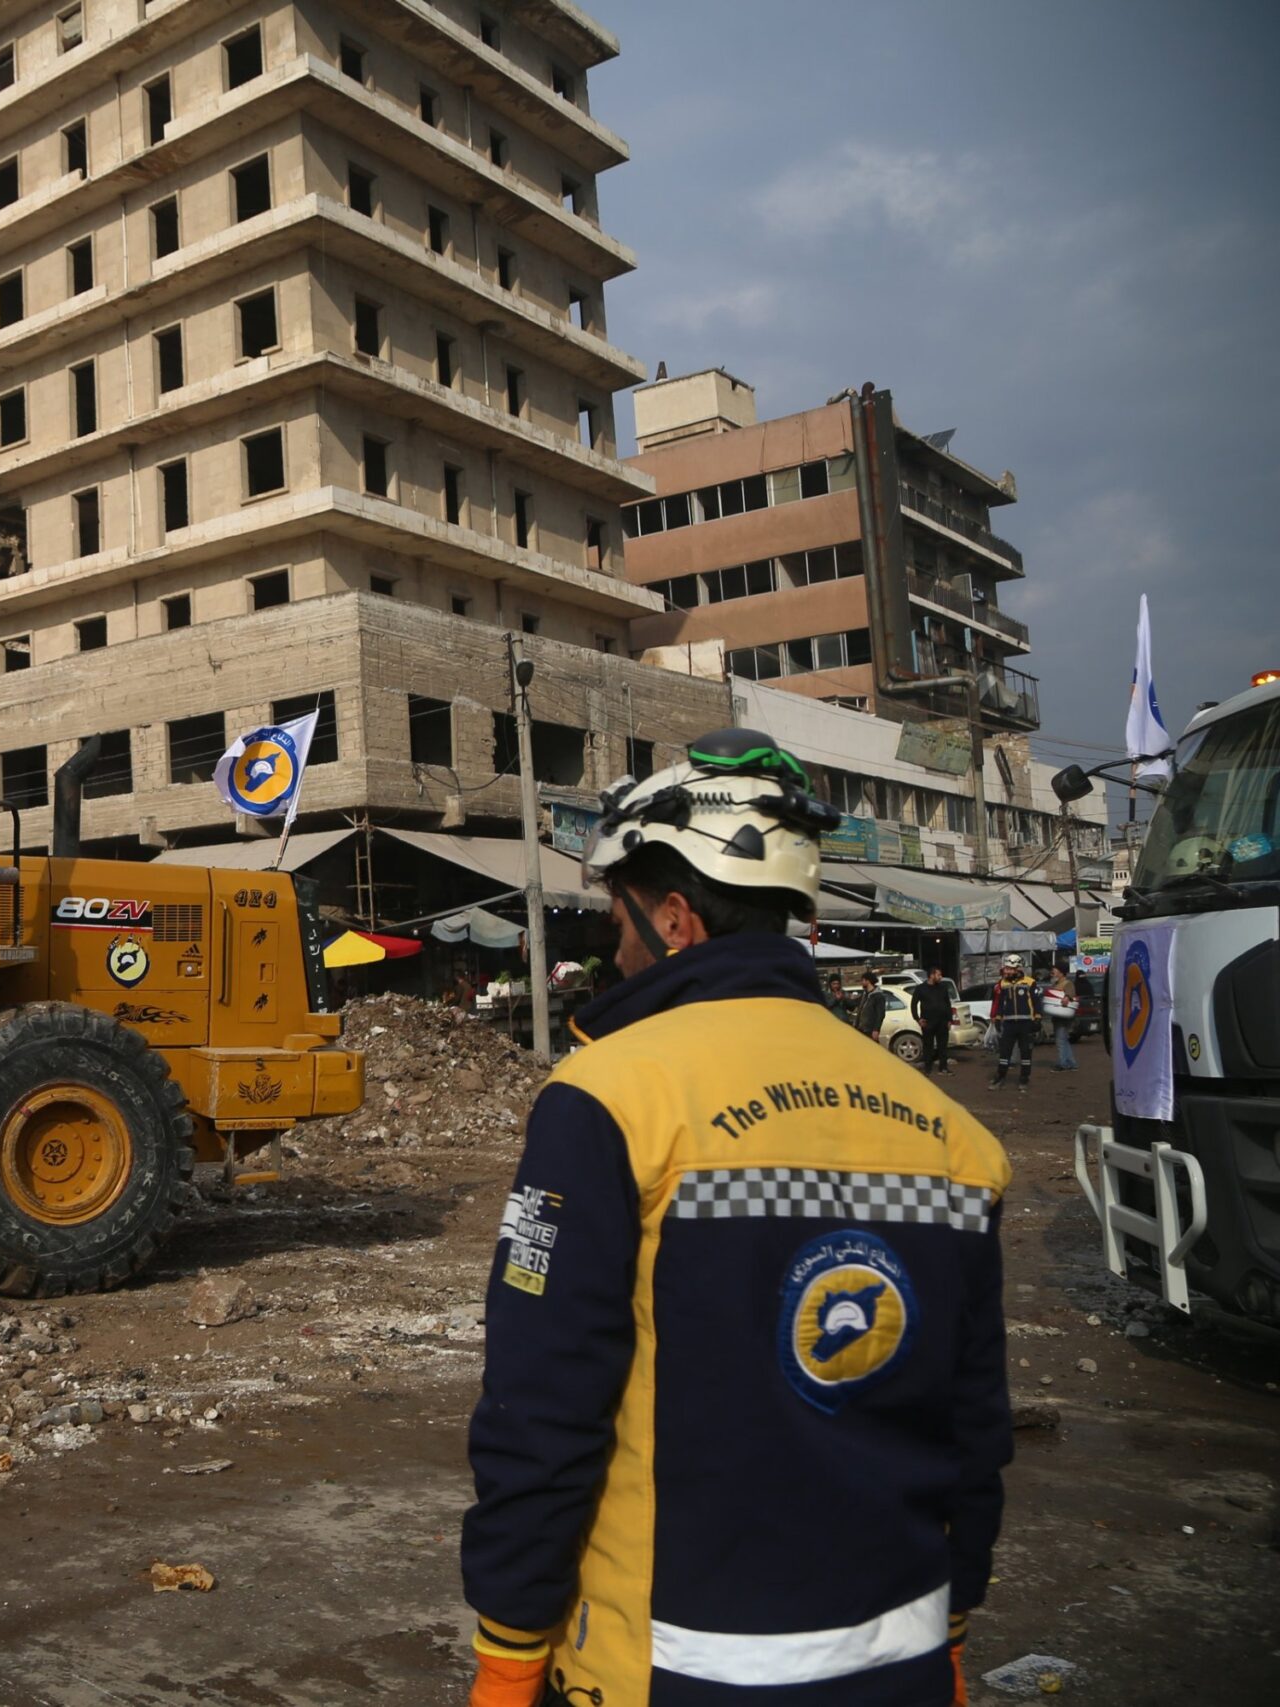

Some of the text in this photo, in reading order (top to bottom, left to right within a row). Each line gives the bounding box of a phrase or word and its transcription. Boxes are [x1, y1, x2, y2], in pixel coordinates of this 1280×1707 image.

[56, 897, 150, 920] 80ZV
[234, 889, 277, 908] 4X4
[711, 1099, 768, 1140] The
[764, 1080, 840, 1113] White
[523, 1184, 548, 1217] THE
[519, 1219, 554, 1245] WHITE
